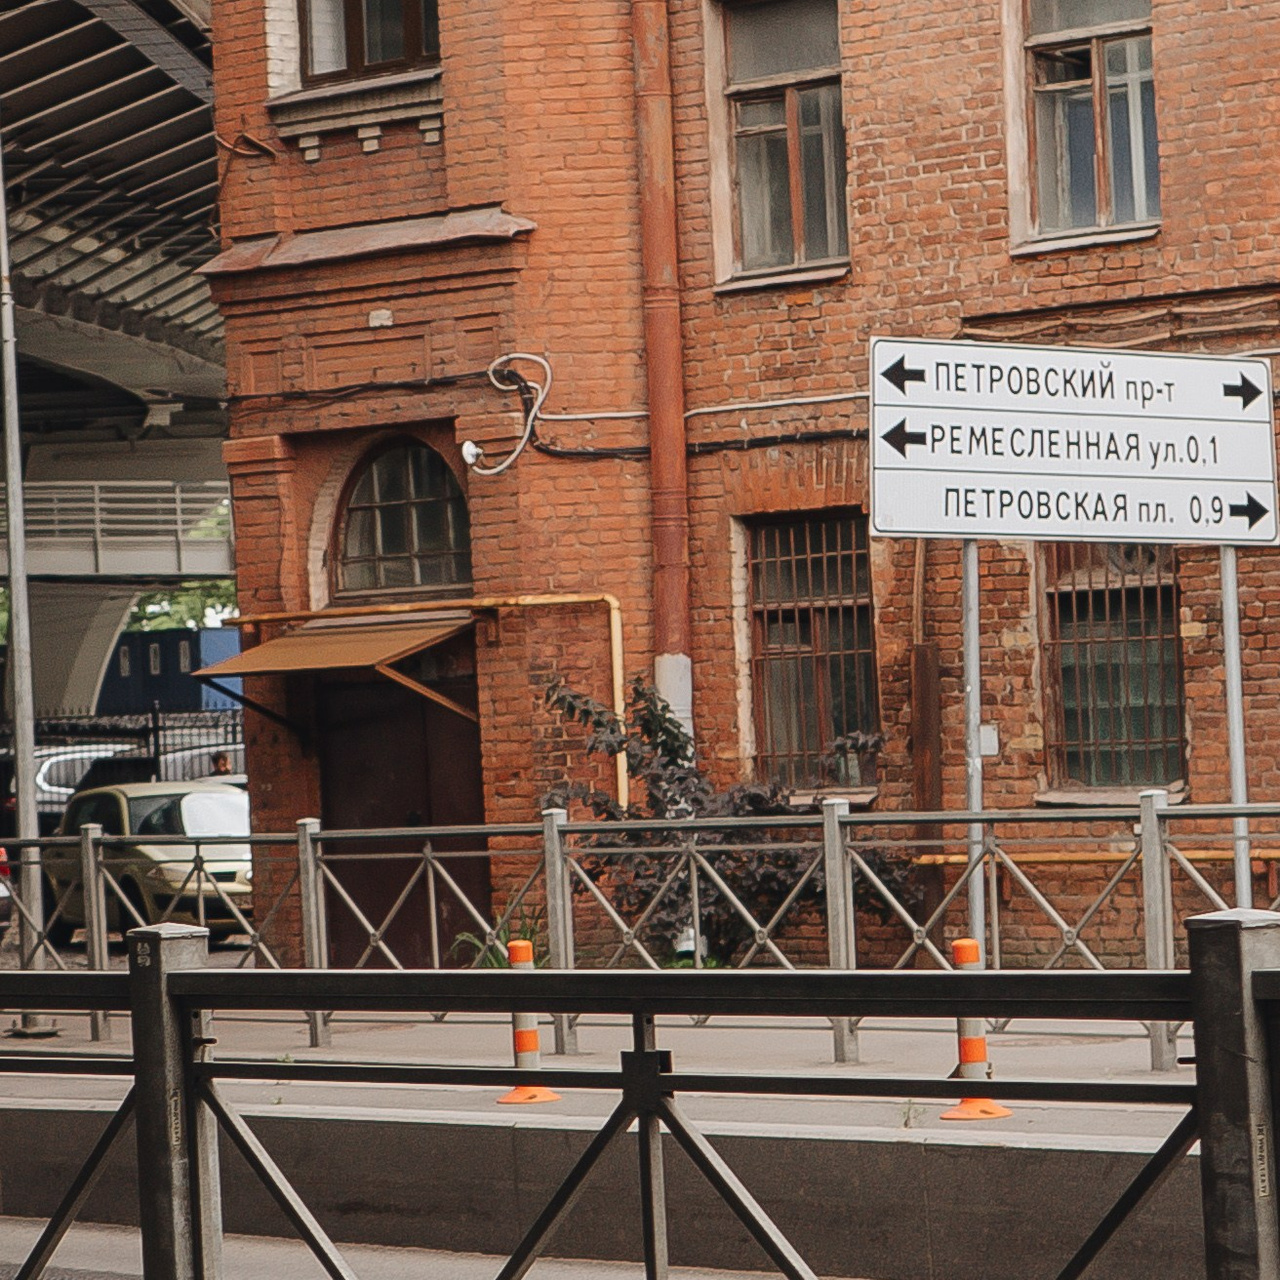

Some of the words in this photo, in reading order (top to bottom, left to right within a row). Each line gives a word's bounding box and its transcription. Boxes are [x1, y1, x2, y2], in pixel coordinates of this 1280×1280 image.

[935, 360, 1115, 400] ПЕТРОВСКИЙ
[1125, 380, 1176, 409] пр-т
[930, 424, 1141, 462] РЕМЕСЛЕННАЯ
[944, 488, 1129, 522] ПЕТРОВСКАЯ
[1138, 501, 1175, 524] пл.
